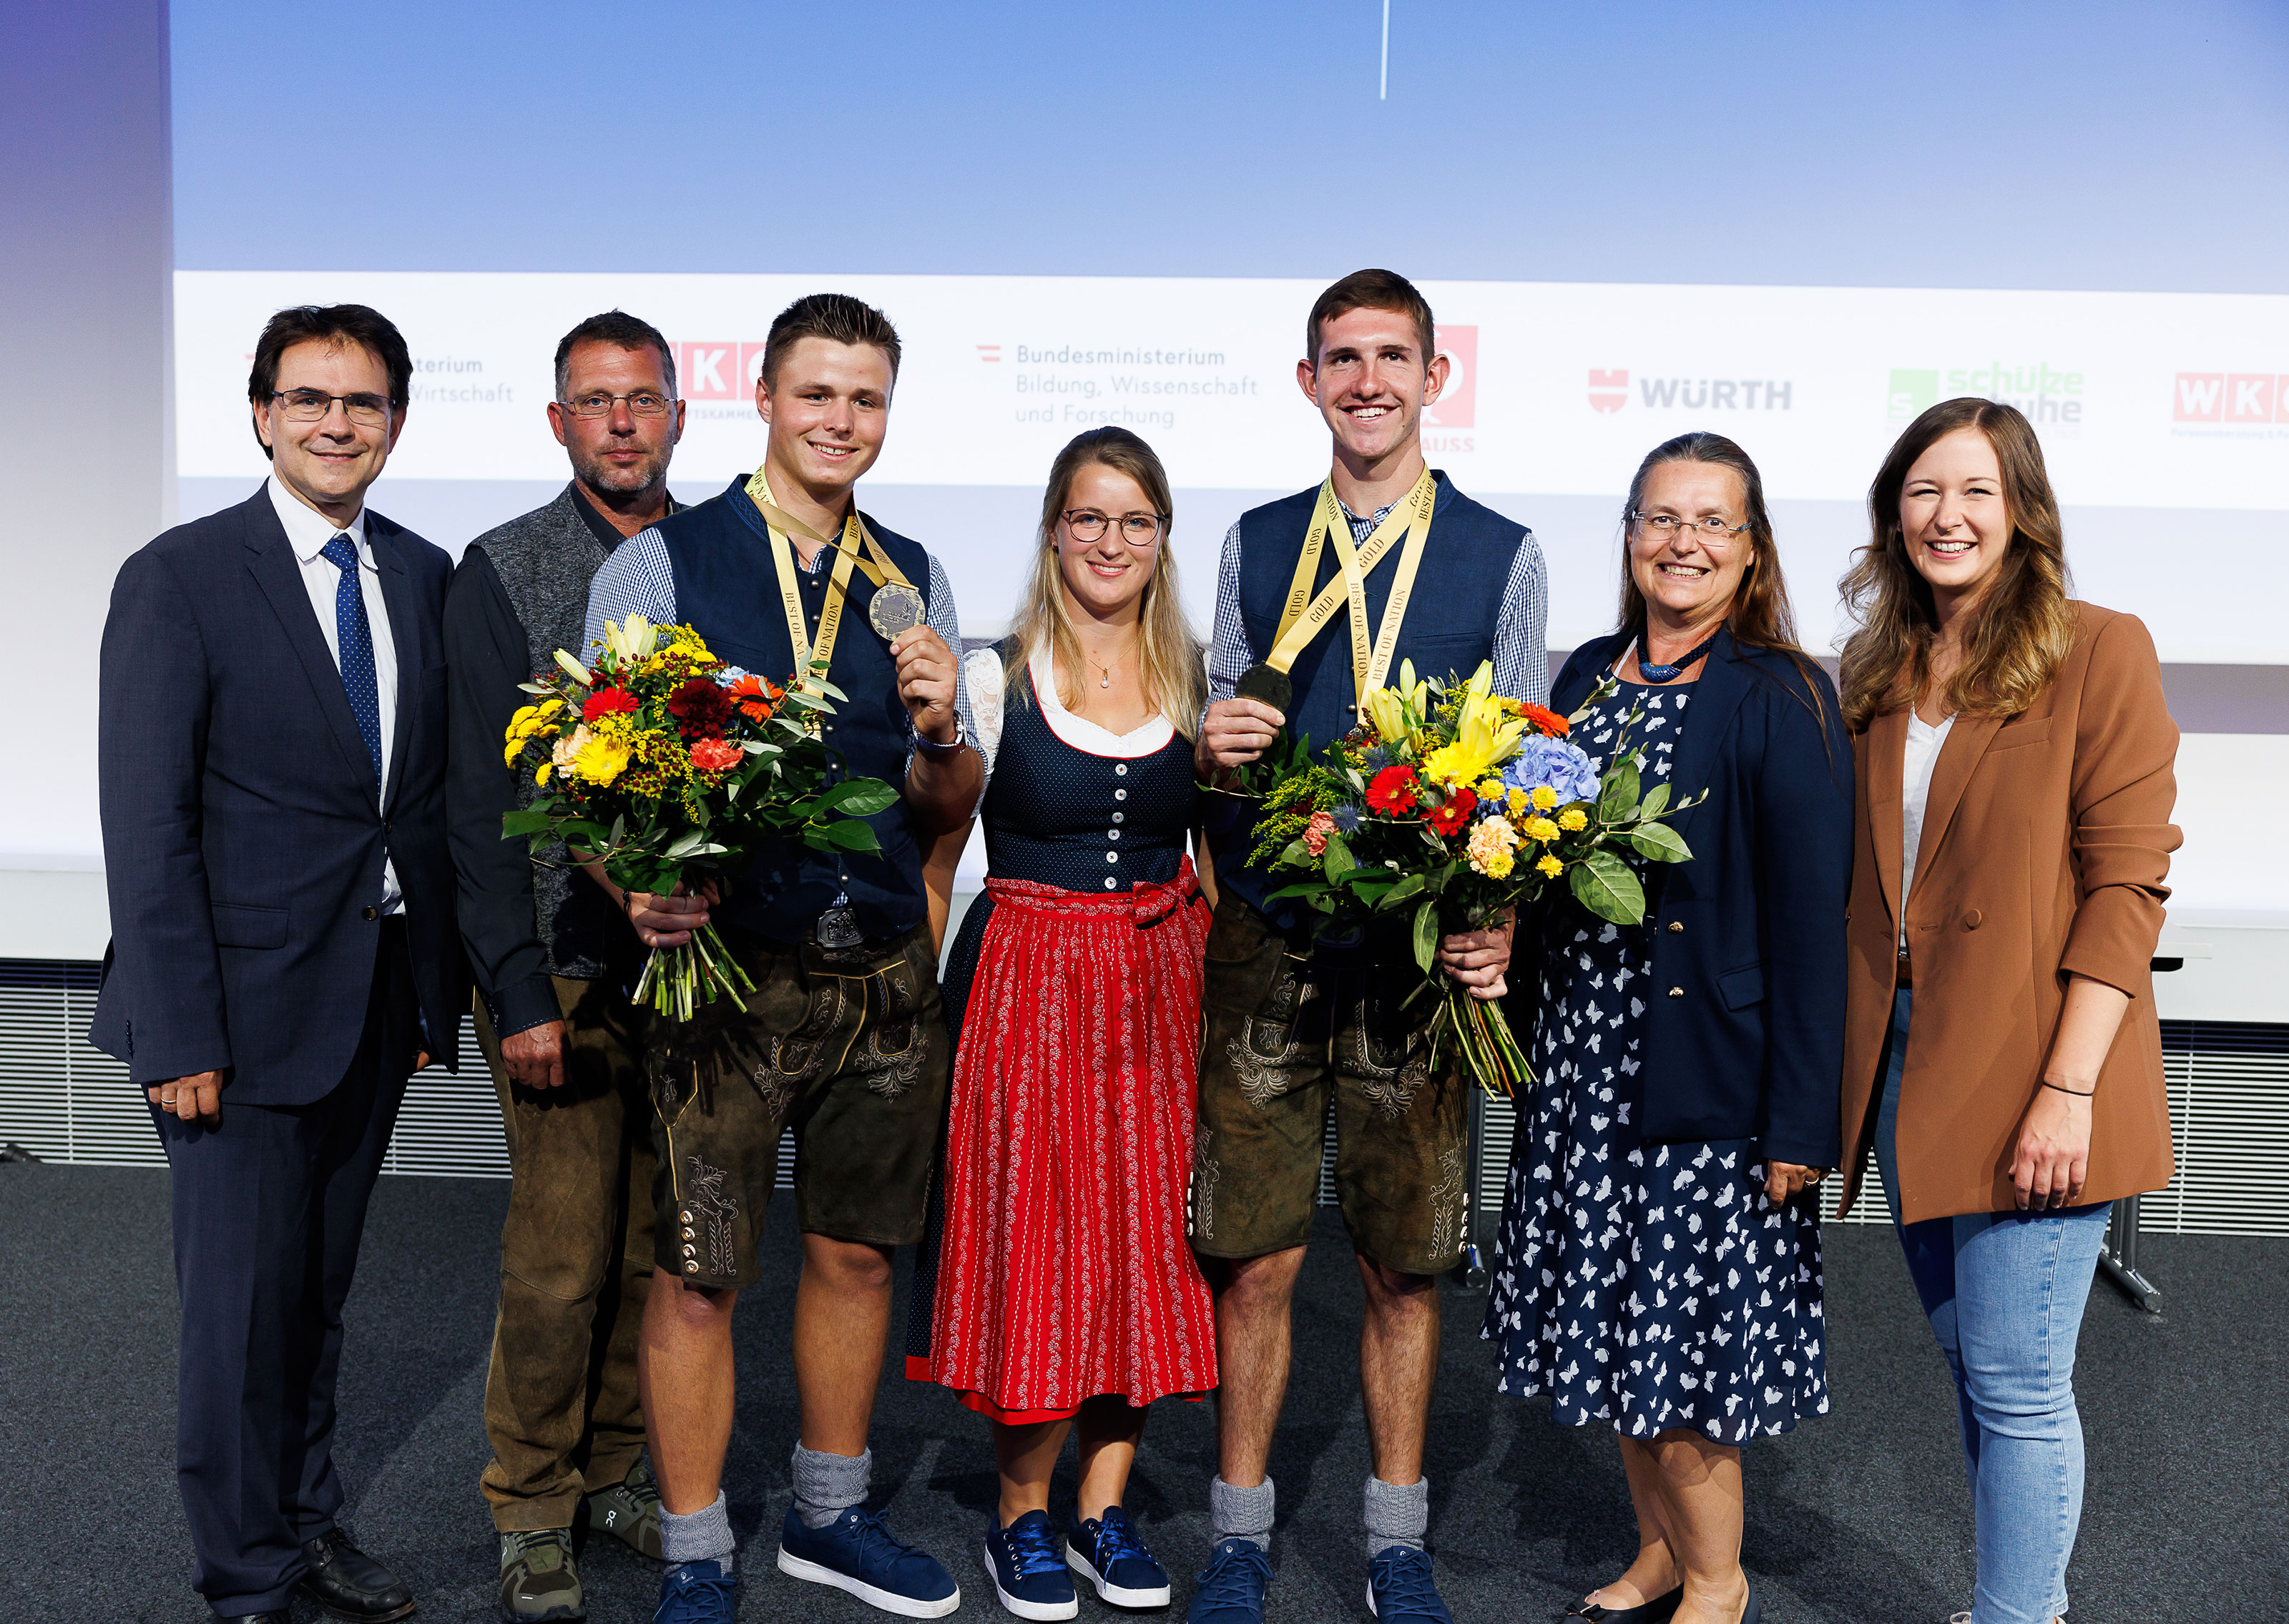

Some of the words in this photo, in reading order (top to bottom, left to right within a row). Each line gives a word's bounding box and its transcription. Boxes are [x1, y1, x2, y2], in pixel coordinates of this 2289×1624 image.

[416, 356, 483, 373] terium
[1016, 345, 1225, 365] Bundesministerium
[1016, 374, 1102, 398] Bildung,
[1111, 375, 1258, 395] Wissenschaft
[1639, 378, 1793, 410] WÜRTH
[1015, 404, 1053, 423] und
[1064, 404, 1175, 429] Forschung
[1418, 493, 1431, 521] BEST
[1426, 479, 1433, 495] OF
[1306, 528, 1322, 555] GOLD
[1358, 538, 1385, 568] GOLD
[785, 592, 799, 620] BEST
[1288, 590, 1305, 616] GOLD
[1309, 596, 1334, 623] GOLD
[1350, 583, 1363, 612] BEST
[1386, 589, 1406, 632] NATION
[791, 622, 803, 637] OF
[822, 603, 839, 642] NATION
[1353, 615, 1364, 631] OF
[818, 642, 830, 656] OF
[1381, 634, 1393, 649] OF
[1355, 634, 1368, 679] NATION
[1372, 651, 1388, 681] BEST
